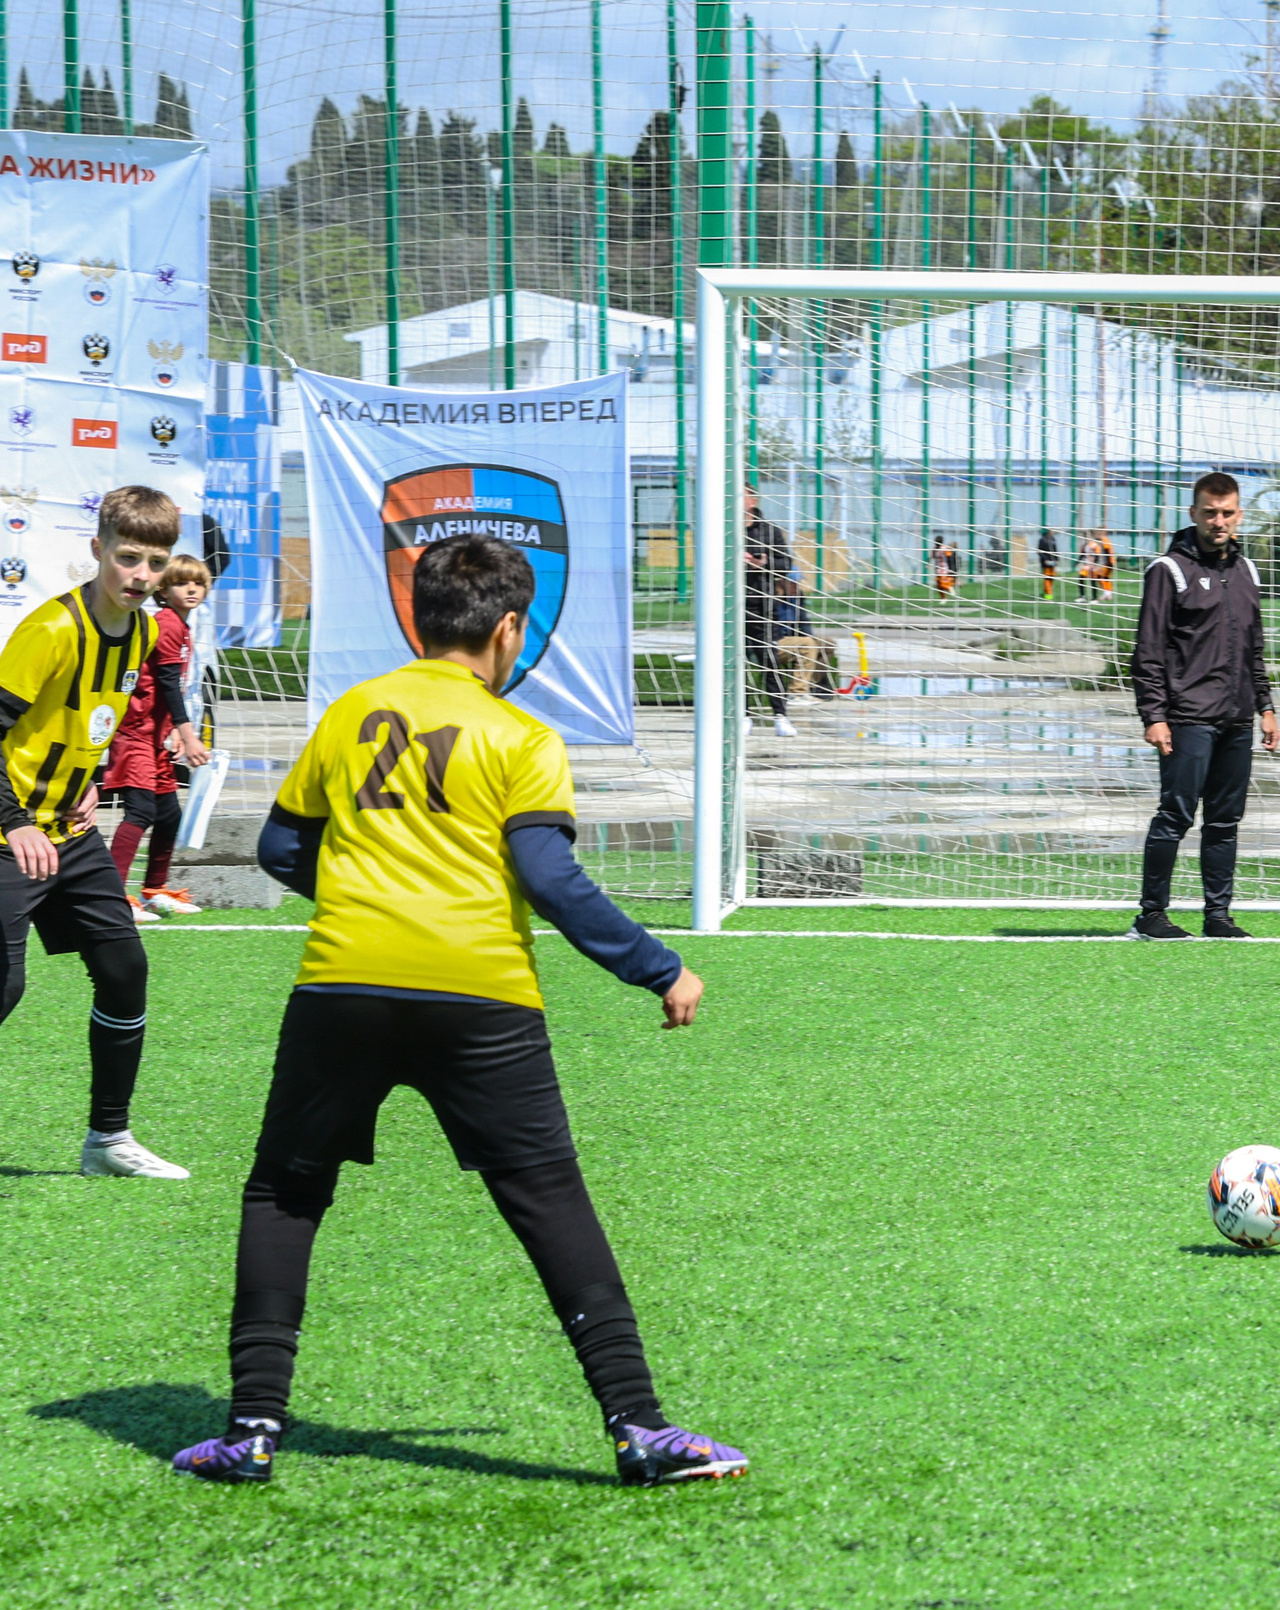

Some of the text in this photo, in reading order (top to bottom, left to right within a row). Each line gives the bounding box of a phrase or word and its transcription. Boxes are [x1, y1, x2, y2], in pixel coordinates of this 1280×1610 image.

[28, 156, 156, 185] ЖИЗНИ»
[318, 398, 618, 424] АКАДЕМИЯ ВПЕРЕД
[433, 496, 513, 511] АКАДЕМИЯ
[413, 519, 542, 545] АЛЕНИЧЕВА
[355, 709, 464, 814] 21
[1221, 1188, 1255, 1234] SELECT
